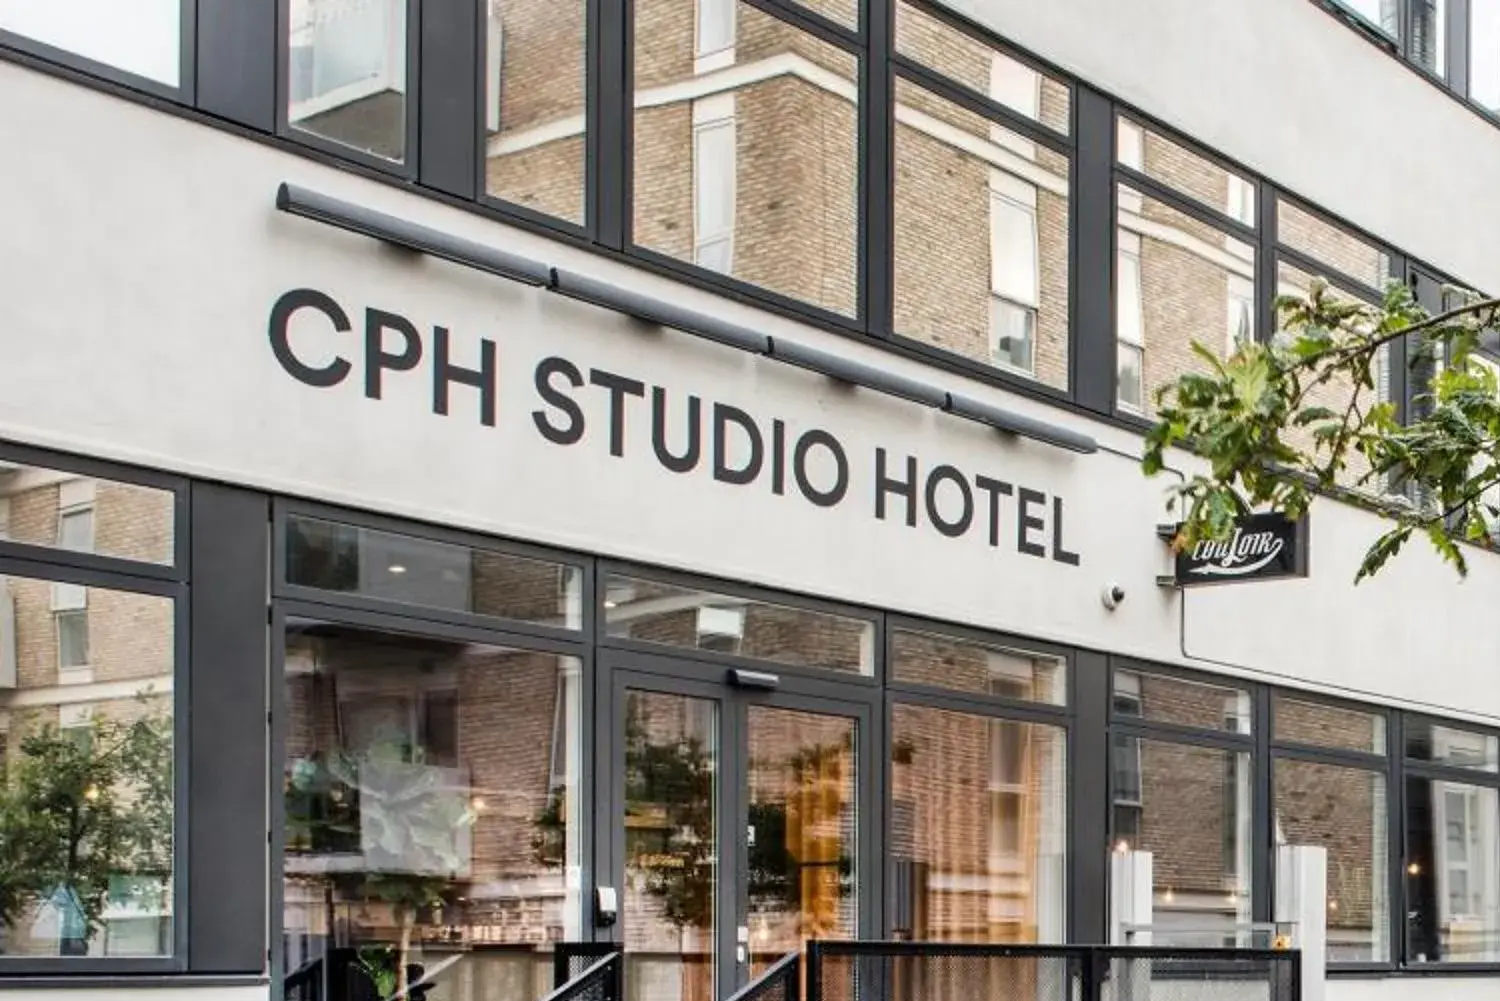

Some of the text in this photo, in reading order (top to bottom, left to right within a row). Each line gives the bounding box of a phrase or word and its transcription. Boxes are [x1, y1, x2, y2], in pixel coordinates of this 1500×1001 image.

[268, 287, 1081, 567] CPH STUDIO HOTEL
